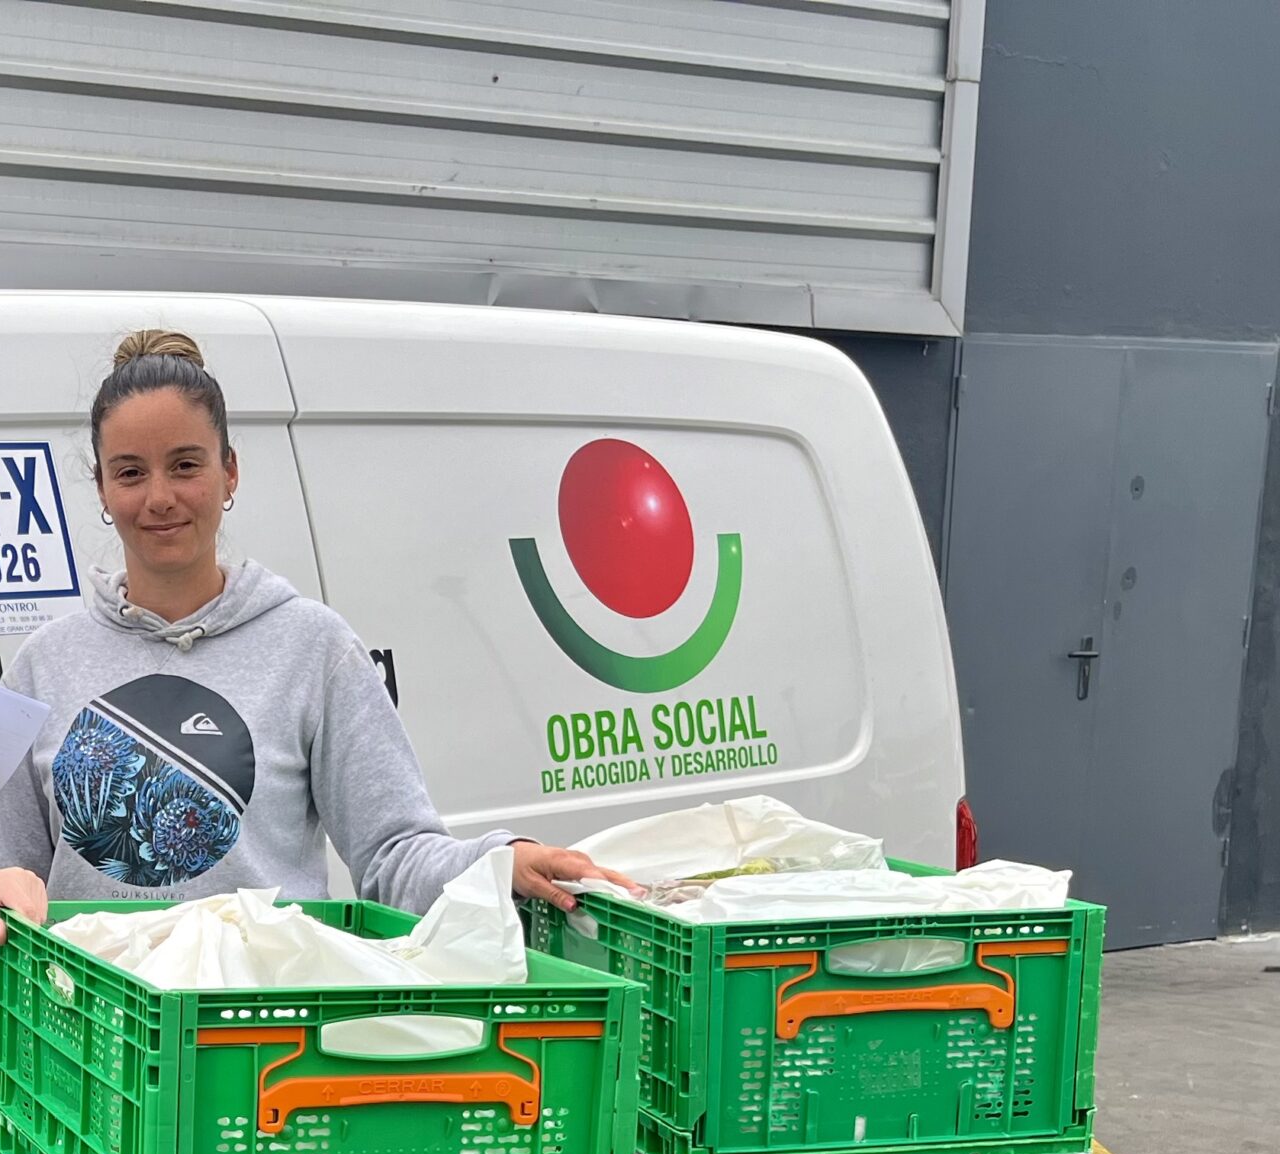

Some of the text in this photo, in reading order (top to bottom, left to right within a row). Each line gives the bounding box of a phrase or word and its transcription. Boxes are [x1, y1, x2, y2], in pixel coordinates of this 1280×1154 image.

[7, 625, 24, 633] GRAN
[546, 695, 768, 763] OBRA SOCIAL
[541, 743, 778, 794] DE ACOGIDA Y DESARROLLO
[358, 1079, 445, 1096] CERRAR
